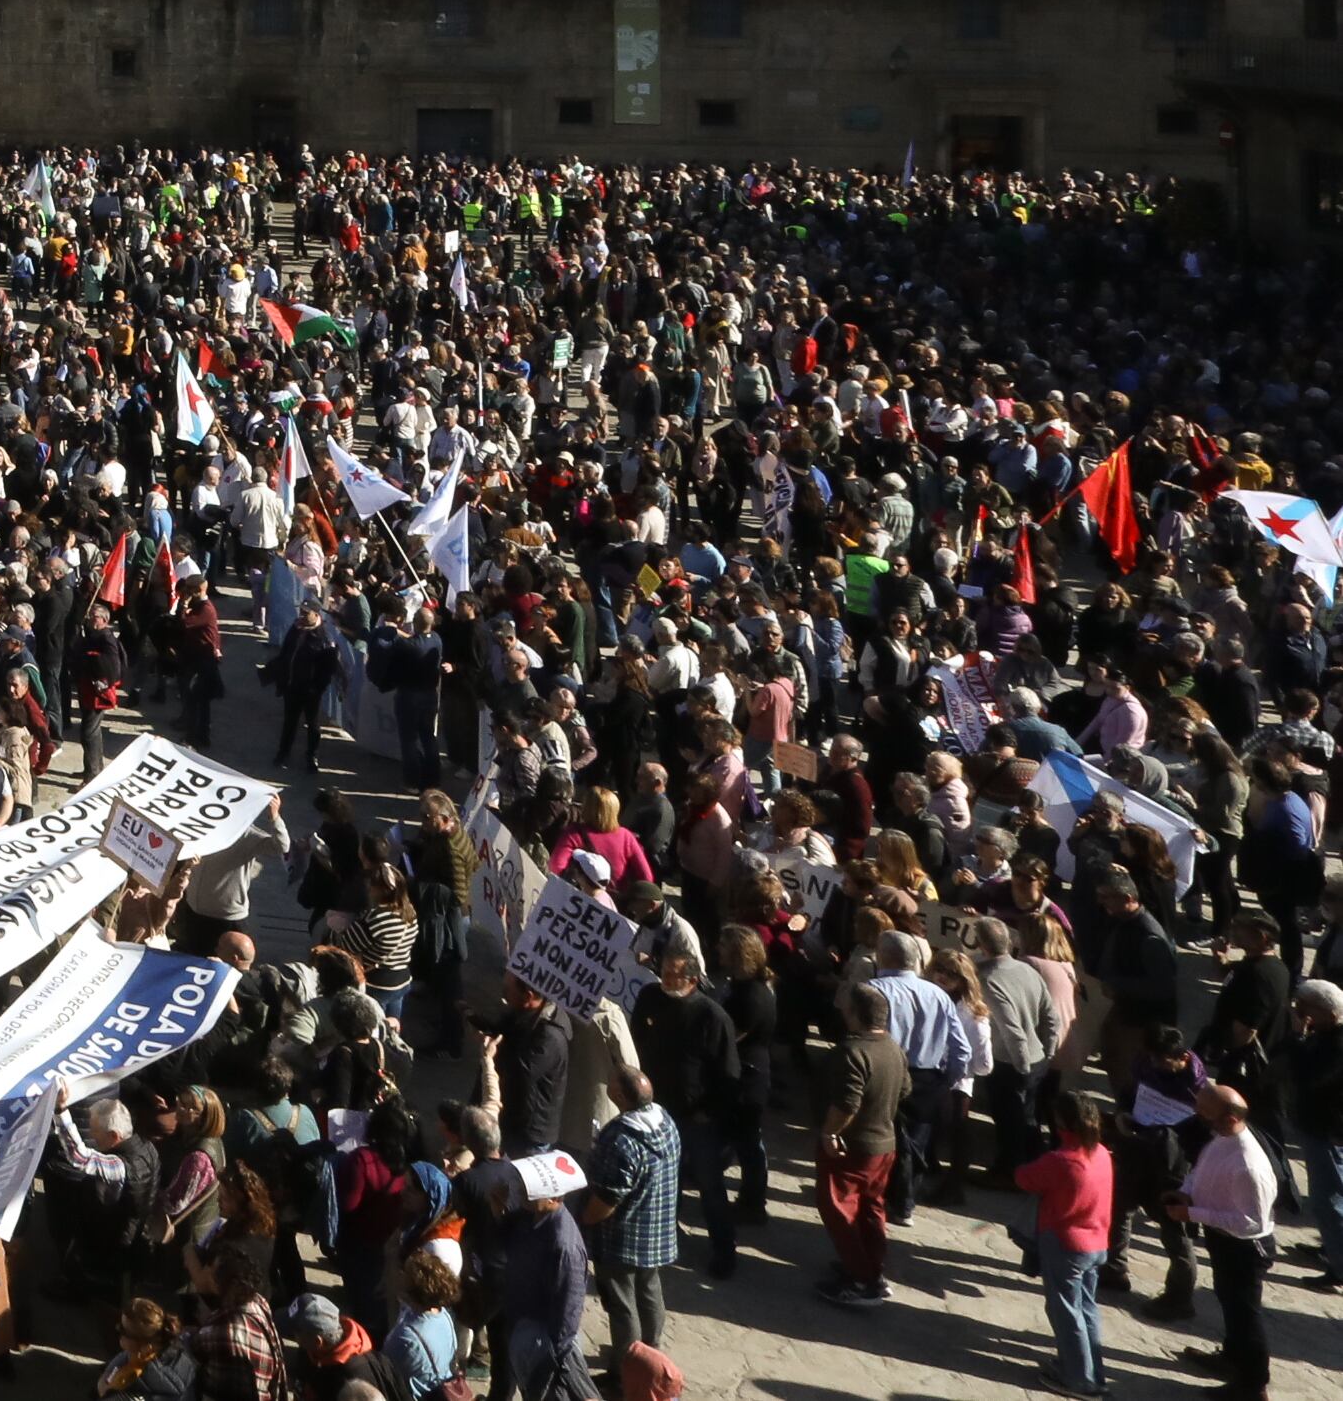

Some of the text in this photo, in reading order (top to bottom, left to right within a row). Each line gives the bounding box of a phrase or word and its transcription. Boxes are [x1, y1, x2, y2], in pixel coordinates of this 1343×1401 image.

[139, 767, 214, 819] PARA
[121, 812, 144, 837] EU
[535, 906, 619, 973] PERSOAL
[563, 895, 620, 941] SEN
[43, 948, 89, 1003] PLATAFORMA
[95, 953, 124, 990] CONTRA
[511, 952, 597, 1020] SANIDADE
[532, 935, 571, 972] NON
[571, 959, 606, 996] HAI
[19, 998, 44, 1022] POLA
[103, 1001, 151, 1036] DE
[149, 964, 217, 1034] POLA
